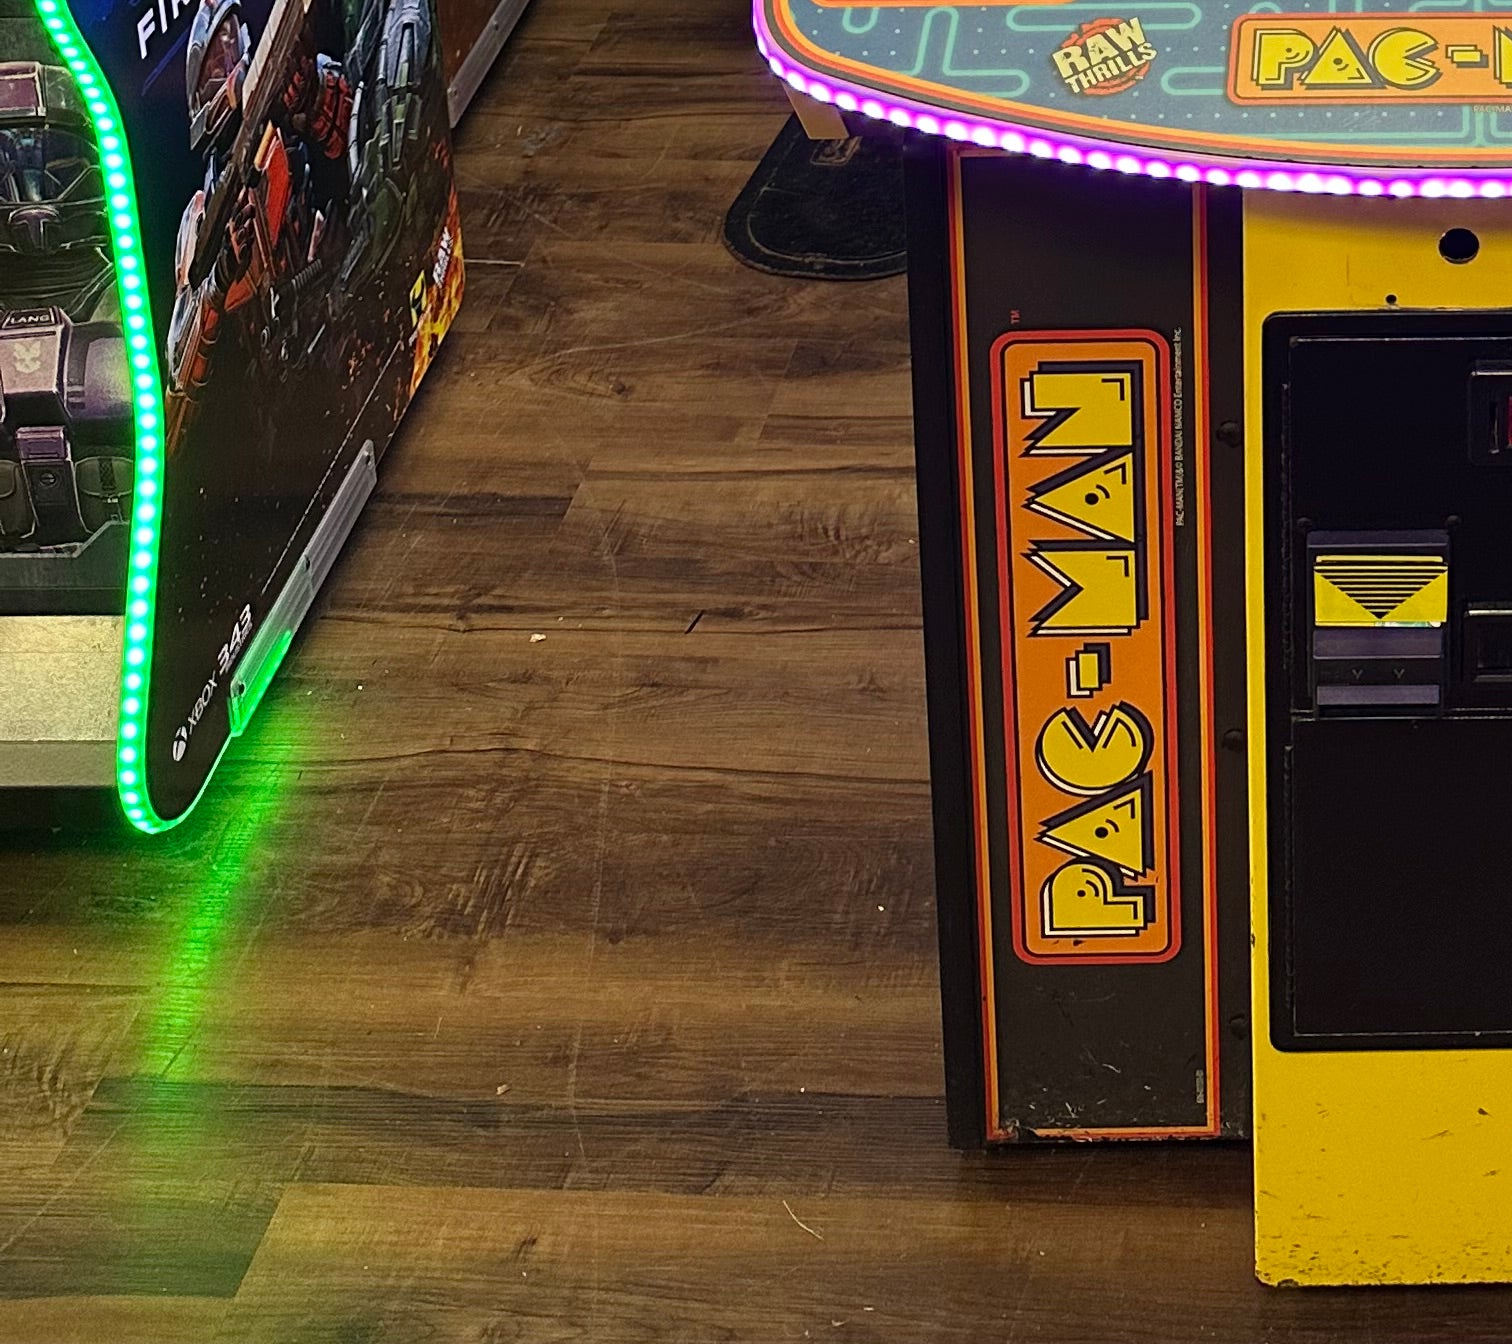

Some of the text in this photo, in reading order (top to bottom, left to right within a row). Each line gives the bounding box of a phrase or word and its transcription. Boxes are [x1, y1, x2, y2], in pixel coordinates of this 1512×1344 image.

[1052, 17, 1146, 79] RAW
[1065, 42, 1158, 93] THRILLS
[1020, 361, 1156, 940] PAC-MAN
[188, 669, 218, 735] XBOX
